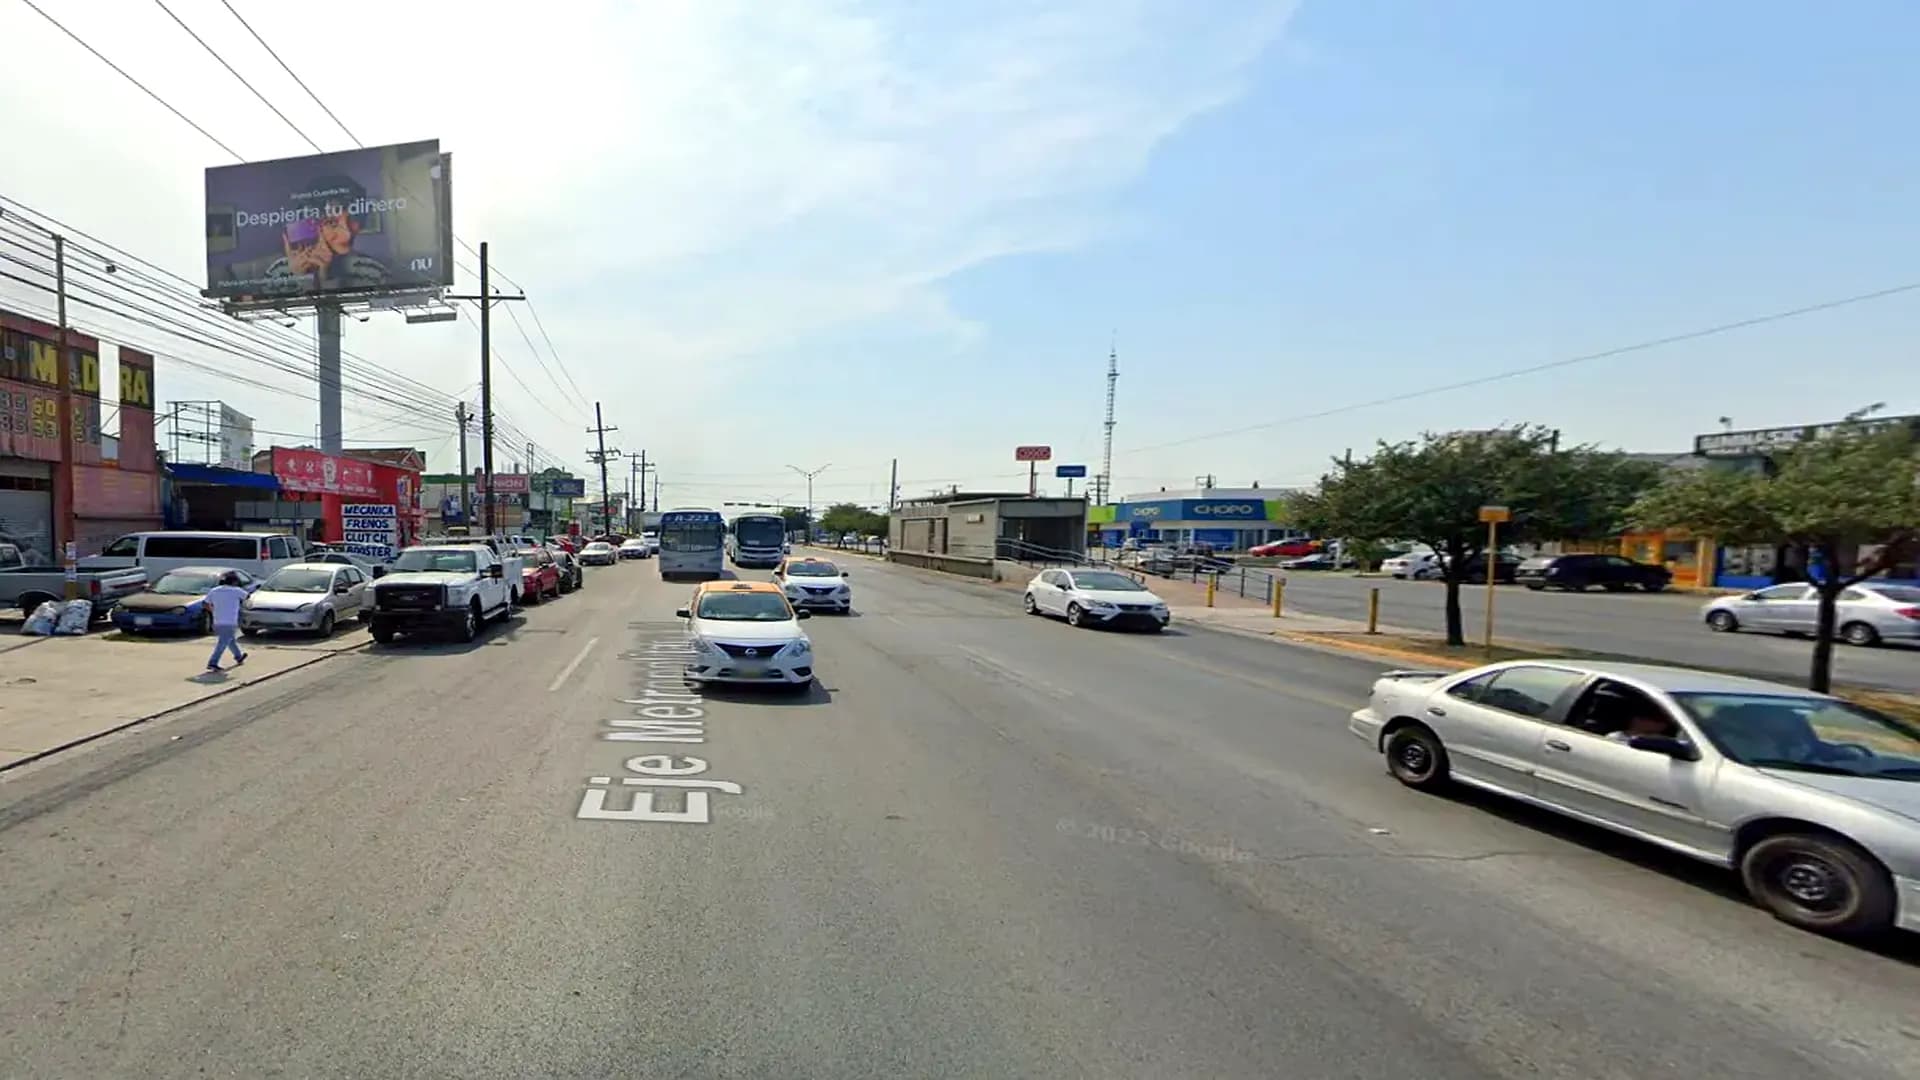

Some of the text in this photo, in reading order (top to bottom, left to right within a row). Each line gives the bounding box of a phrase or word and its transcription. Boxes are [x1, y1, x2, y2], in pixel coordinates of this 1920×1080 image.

[236, 197, 408, 228] Despierta tu dinero
[344, 505, 393, 515] MECANICA
[1193, 505, 1253, 514] CHOPO
[345, 518, 389, 528] FRENOS
